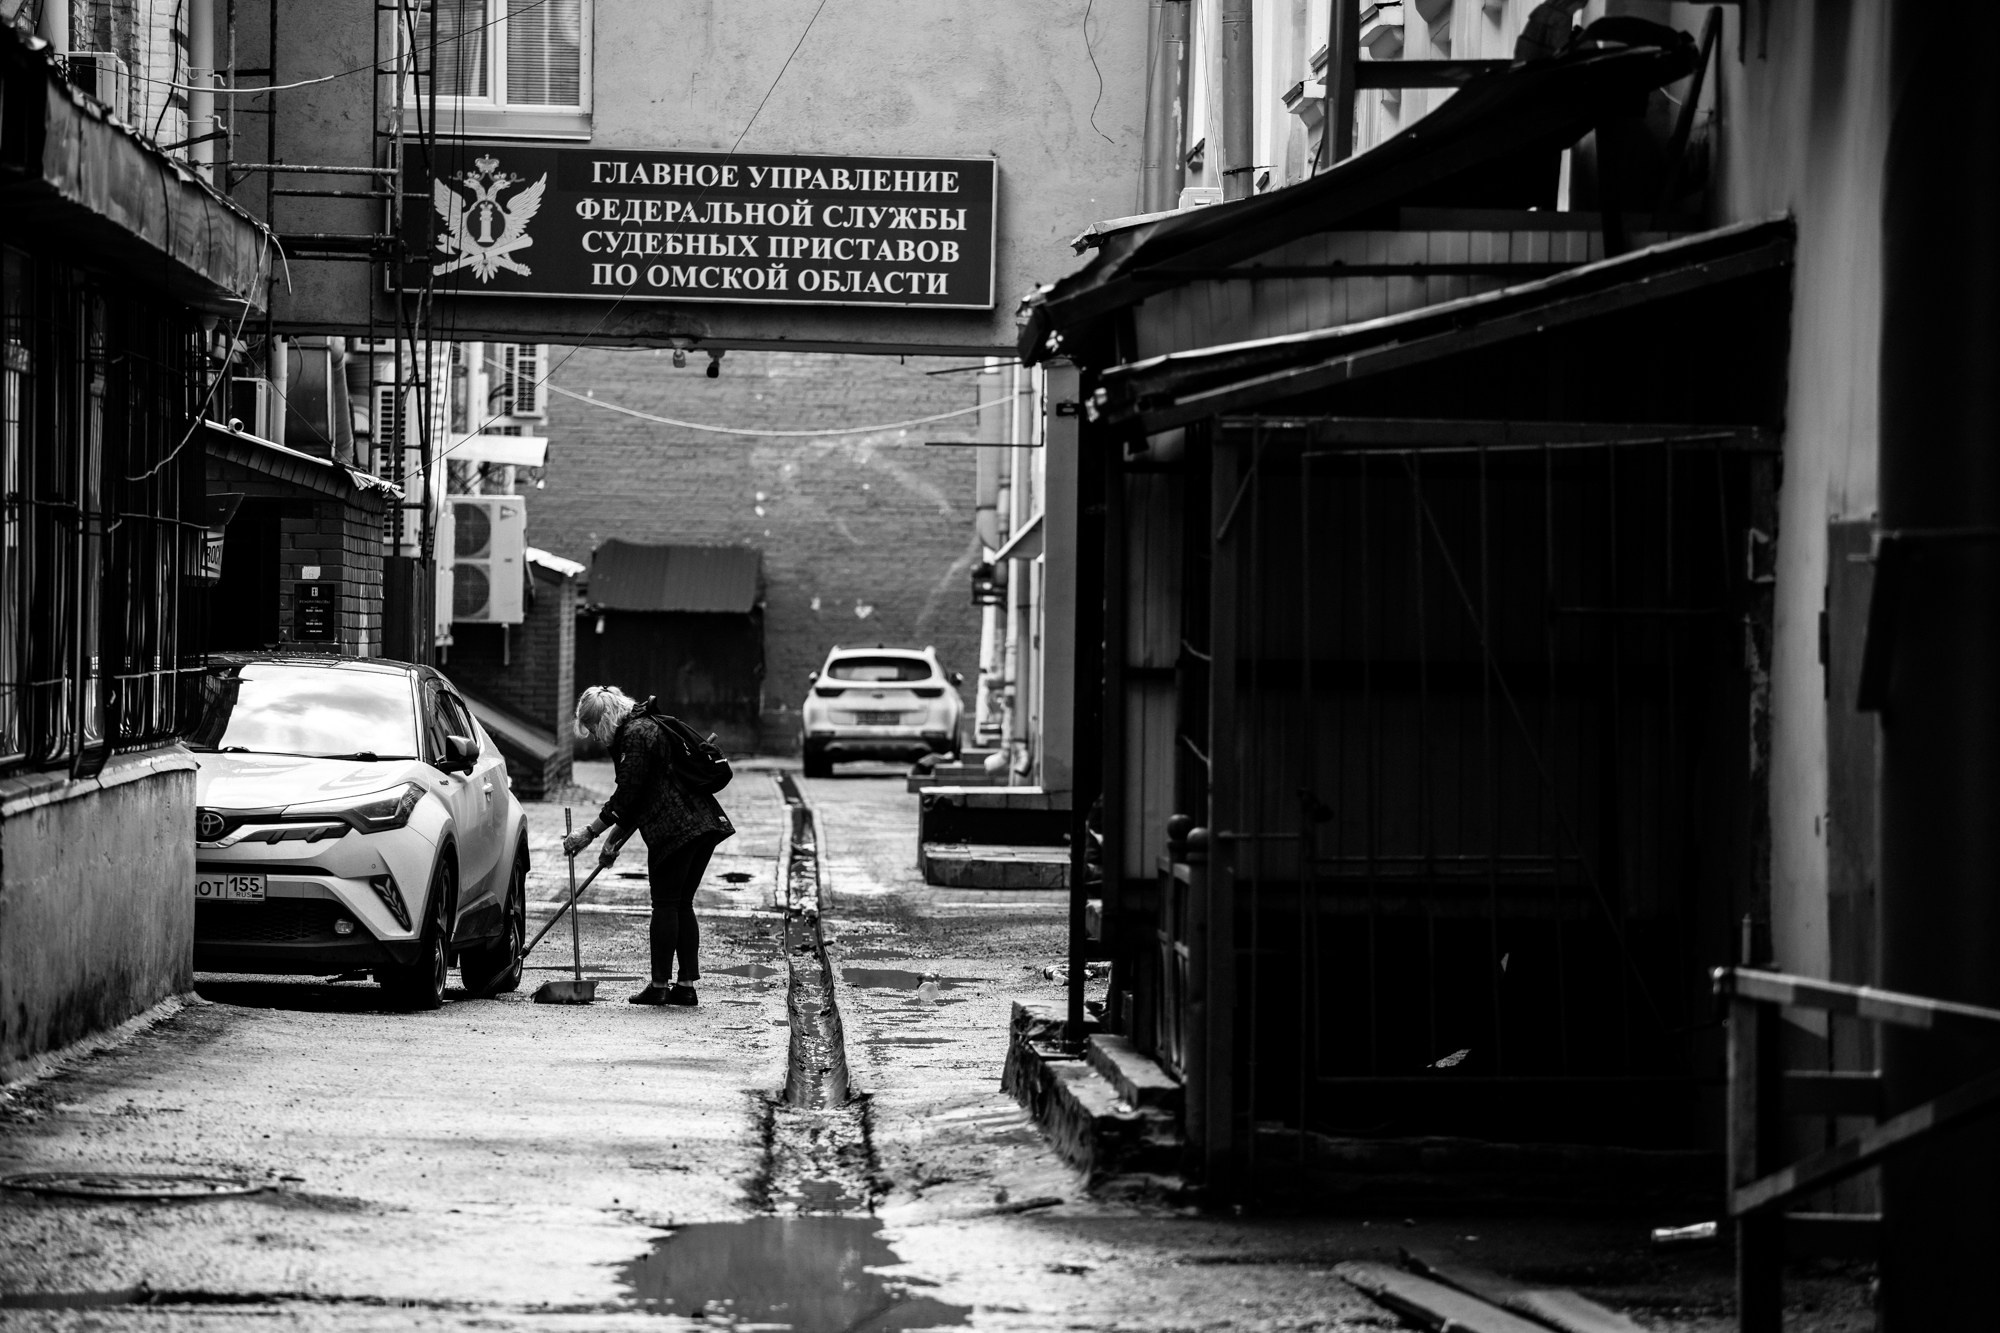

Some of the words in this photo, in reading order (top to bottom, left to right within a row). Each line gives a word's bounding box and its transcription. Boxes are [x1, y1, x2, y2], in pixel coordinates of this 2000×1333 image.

[592, 161, 739, 188] ГЛАВНОЕ
[747, 166, 960, 194] УПРАВЛЕНИЕ
[575, 198, 814, 227] ФЕДЕРАЛЬНОЙ
[822, 205, 967, 231] СЛУЖБЫ
[581, 230, 759, 259] СУДЕБНЫХ
[767, 235, 960, 263] ПРИСТАВОВ
[591, 263, 638, 286] ПО
[647, 262, 789, 291] ОМСКОЙ
[797, 269, 949, 295] ОБЛАСТИ
[195, 881, 224, 897] OT
[229, 877, 260, 892] 155
